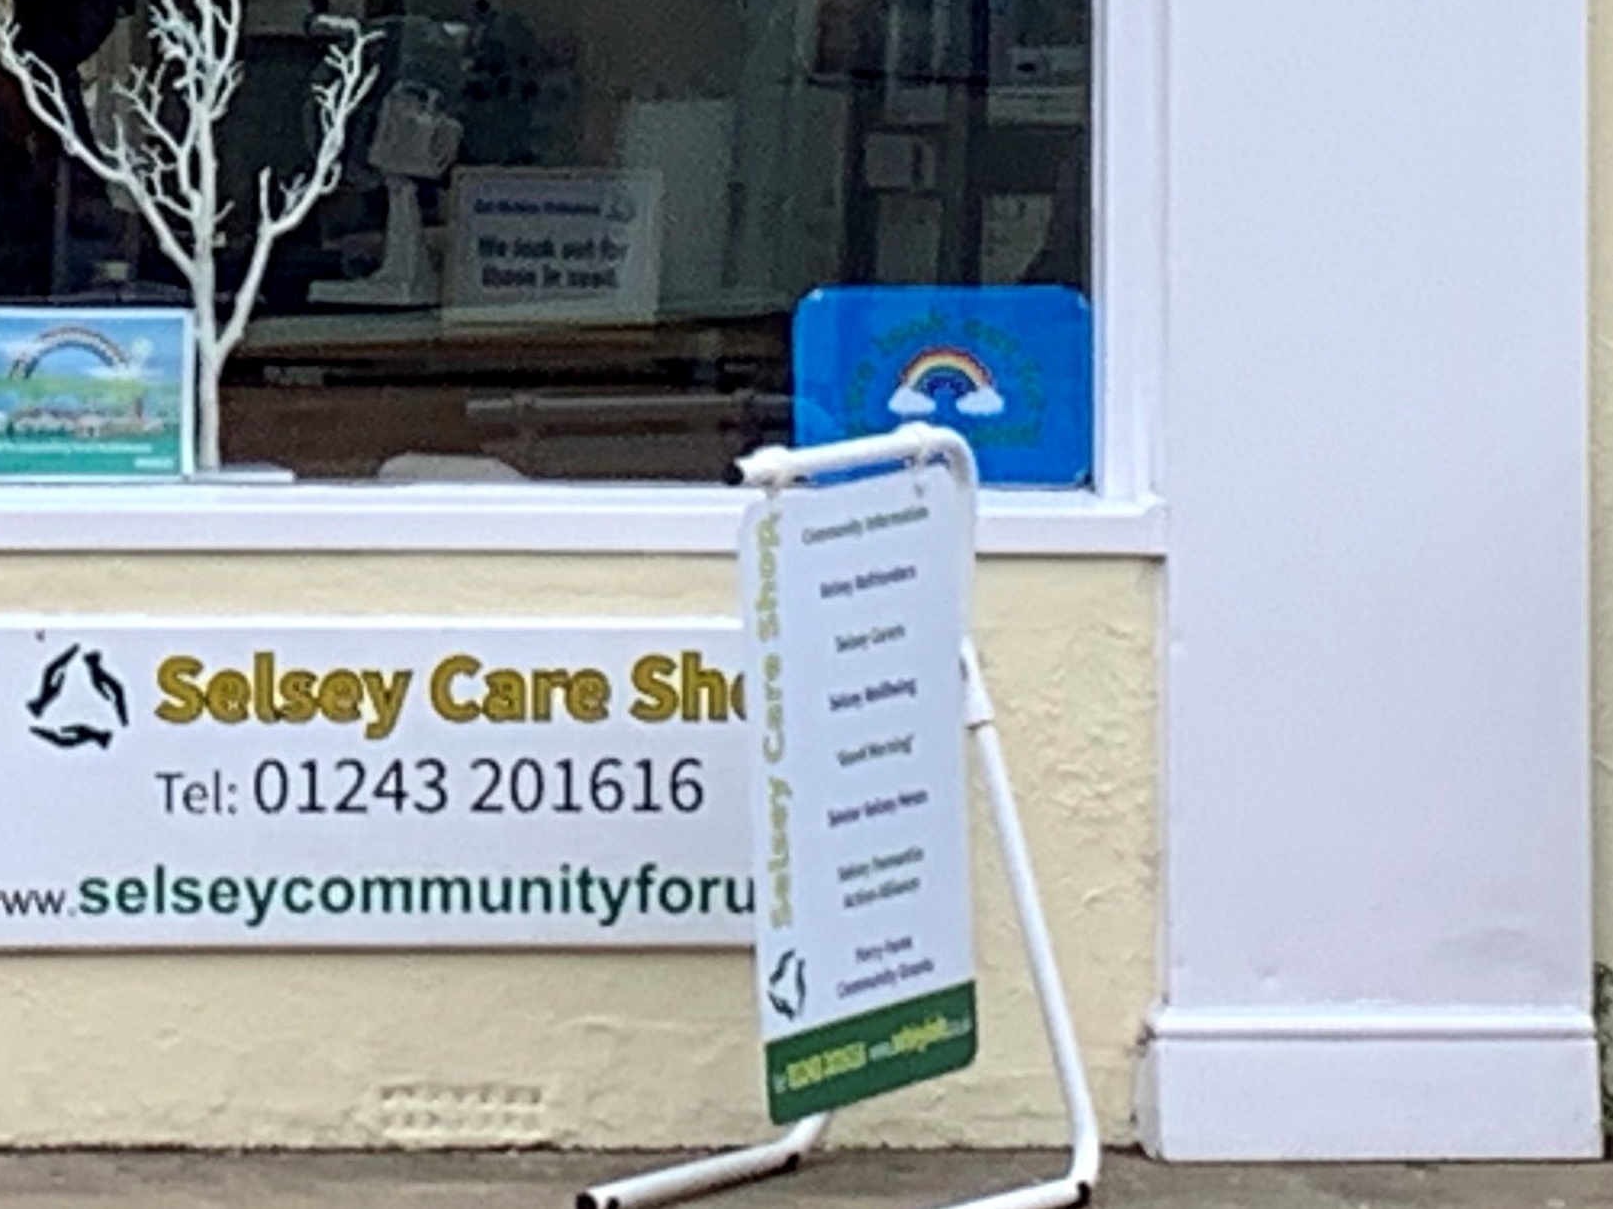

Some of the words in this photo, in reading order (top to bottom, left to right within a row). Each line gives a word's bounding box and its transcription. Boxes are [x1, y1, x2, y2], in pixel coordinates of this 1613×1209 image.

[755, 510, 782, 643] Shop
[154, 652, 411, 739] Selsey
[430, 654, 611, 725] Care
[762, 653, 785, 764] Care
[155, 770, 238, 816] Tel:
[254, 757, 448, 815] 01243
[470, 757, 705, 815] 201616
[766, 775, 793, 931] Selsey
